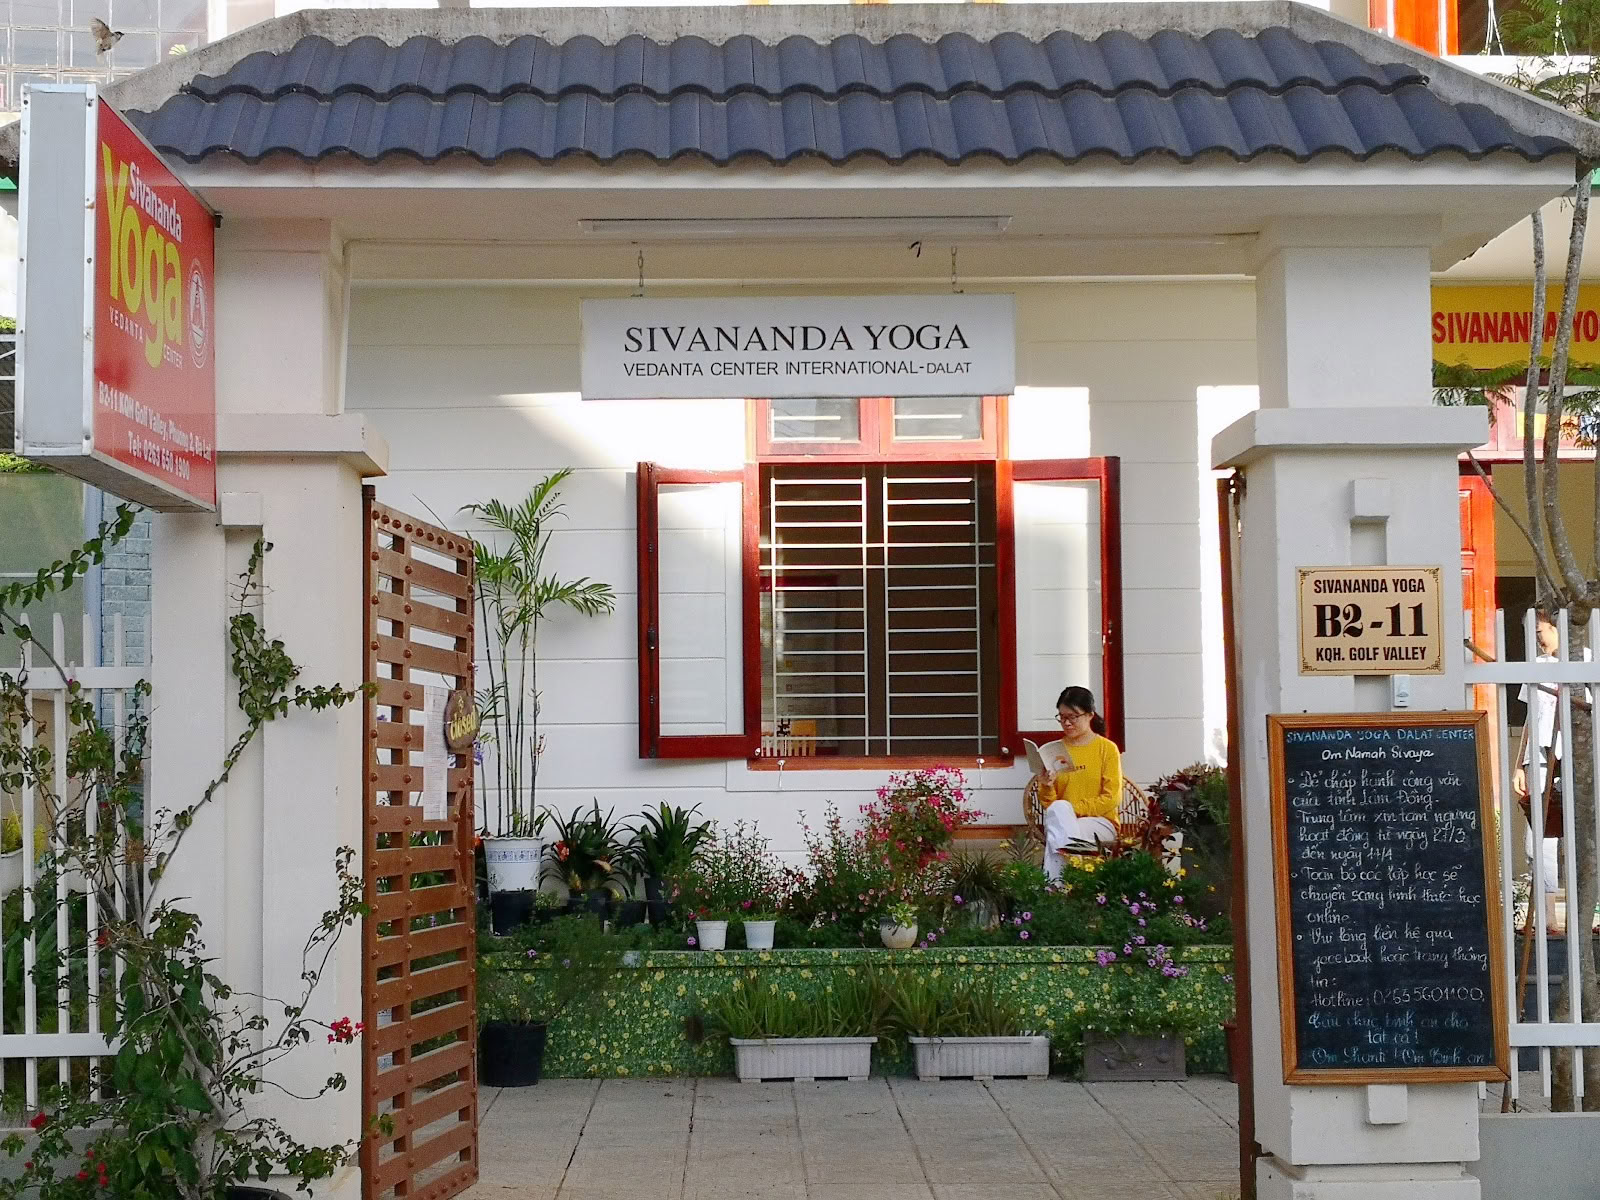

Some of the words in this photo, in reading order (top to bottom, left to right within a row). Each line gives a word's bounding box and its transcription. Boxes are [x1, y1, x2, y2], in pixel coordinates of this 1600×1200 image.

[129, 161, 182, 243] Sivananda
[102, 141, 182, 368] Yoga
[109, 305, 144, 344] VEDANTA
[623, 325, 854, 353] SIVANANDA
[862, 324, 970, 351] YOGA
[1432, 311, 1560, 344] SIVANANA
[623, 362, 704, 377] VEDANTA
[710, 361, 779, 377] CENTER
[99, 381, 118, 411] B2-11
[1314, 579, 1388, 594] SIVANANDA
[1392, 578, 1426, 593] YOGA
[1313, 602, 1429, 638] B2-11
[1316, 647, 1345, 663] KQH.
[1349, 647, 1380, 661] GOLF
[1383, 646, 1427, 661] VALLEY
[1287, 730, 1352, 743] SIVANANDA
[1357, 730, 1391, 740] YOGA
[1397, 728, 1433, 740] DALAT
[1321, 749, 1342, 761] Om
[1345, 746, 1386, 760] Namah
